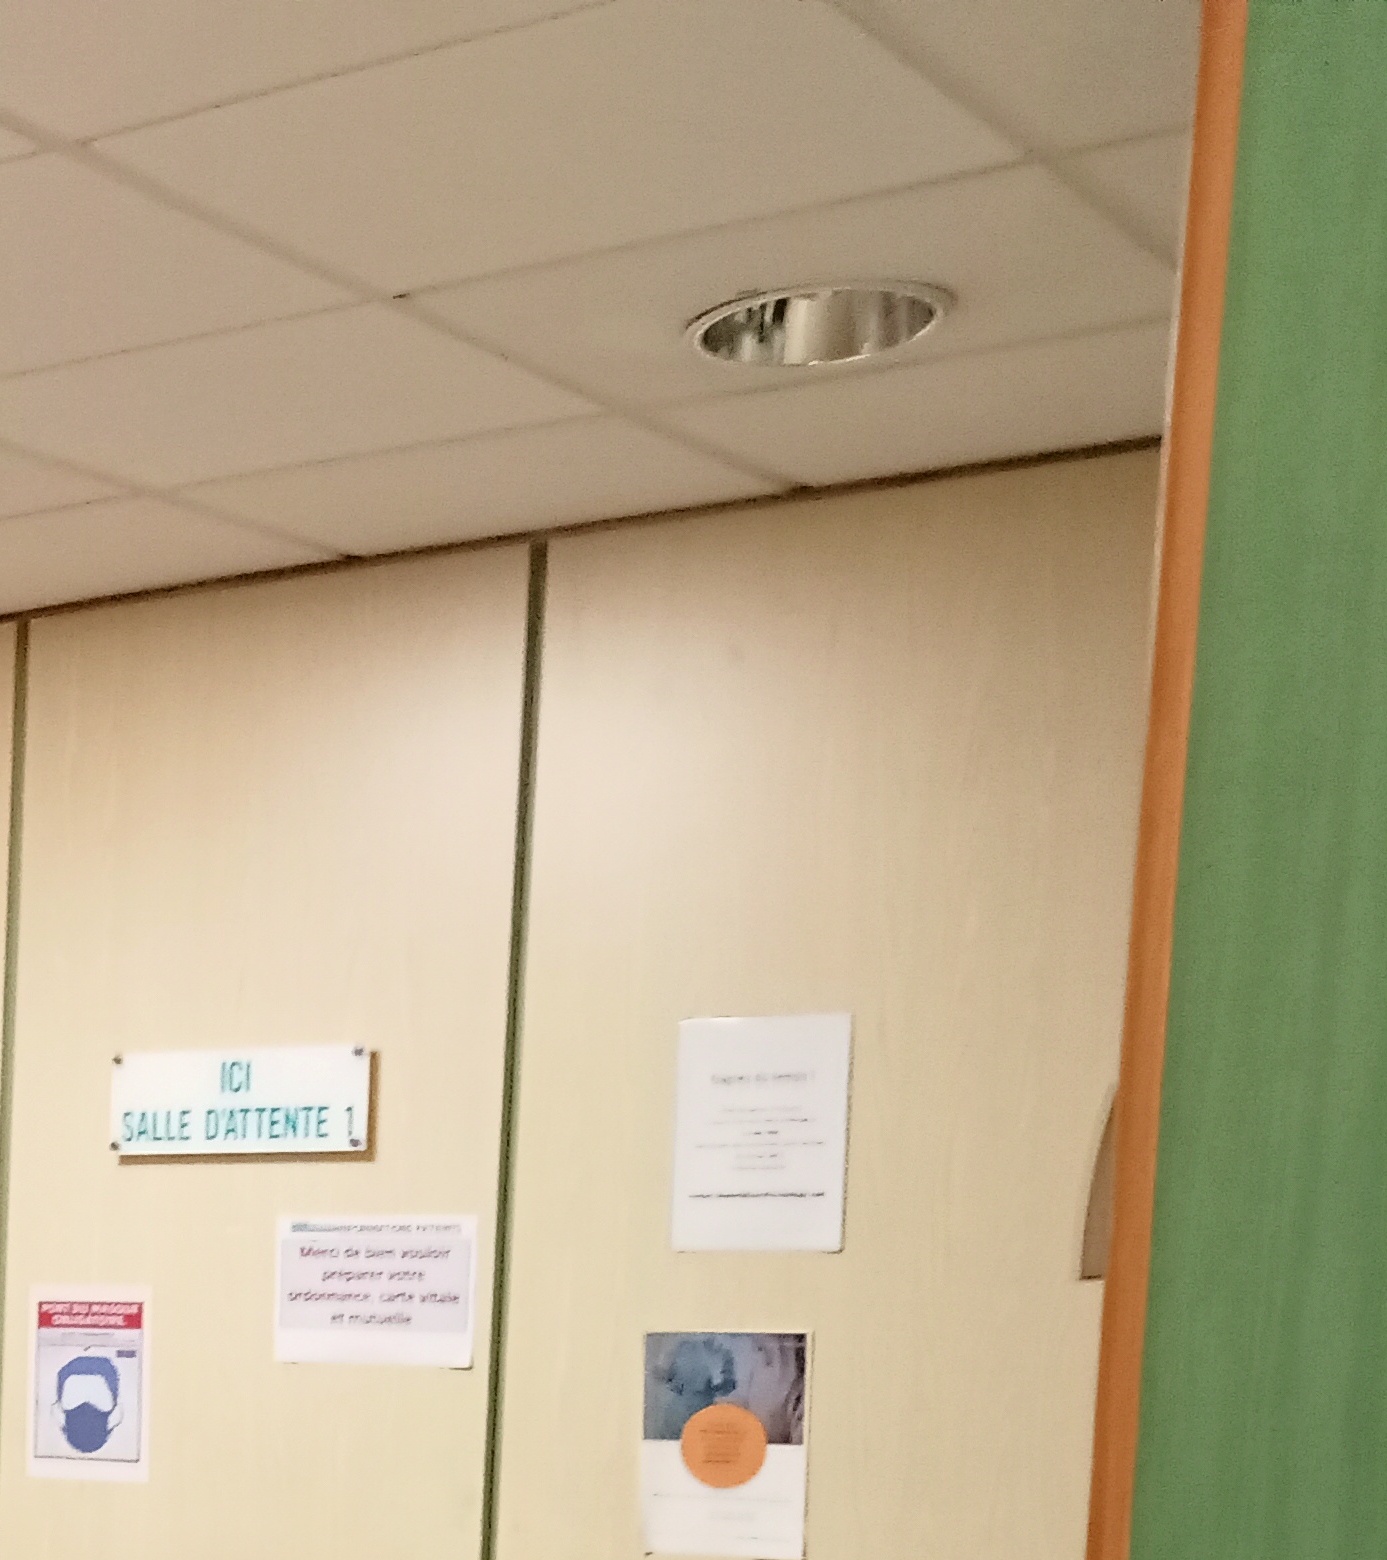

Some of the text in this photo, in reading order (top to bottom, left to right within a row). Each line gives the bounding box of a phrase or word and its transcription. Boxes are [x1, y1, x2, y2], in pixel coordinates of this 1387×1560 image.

[220, 1061, 252, 1093] ICI
[122, 1105, 355, 1142] SALLE D'ATTENTE 1
